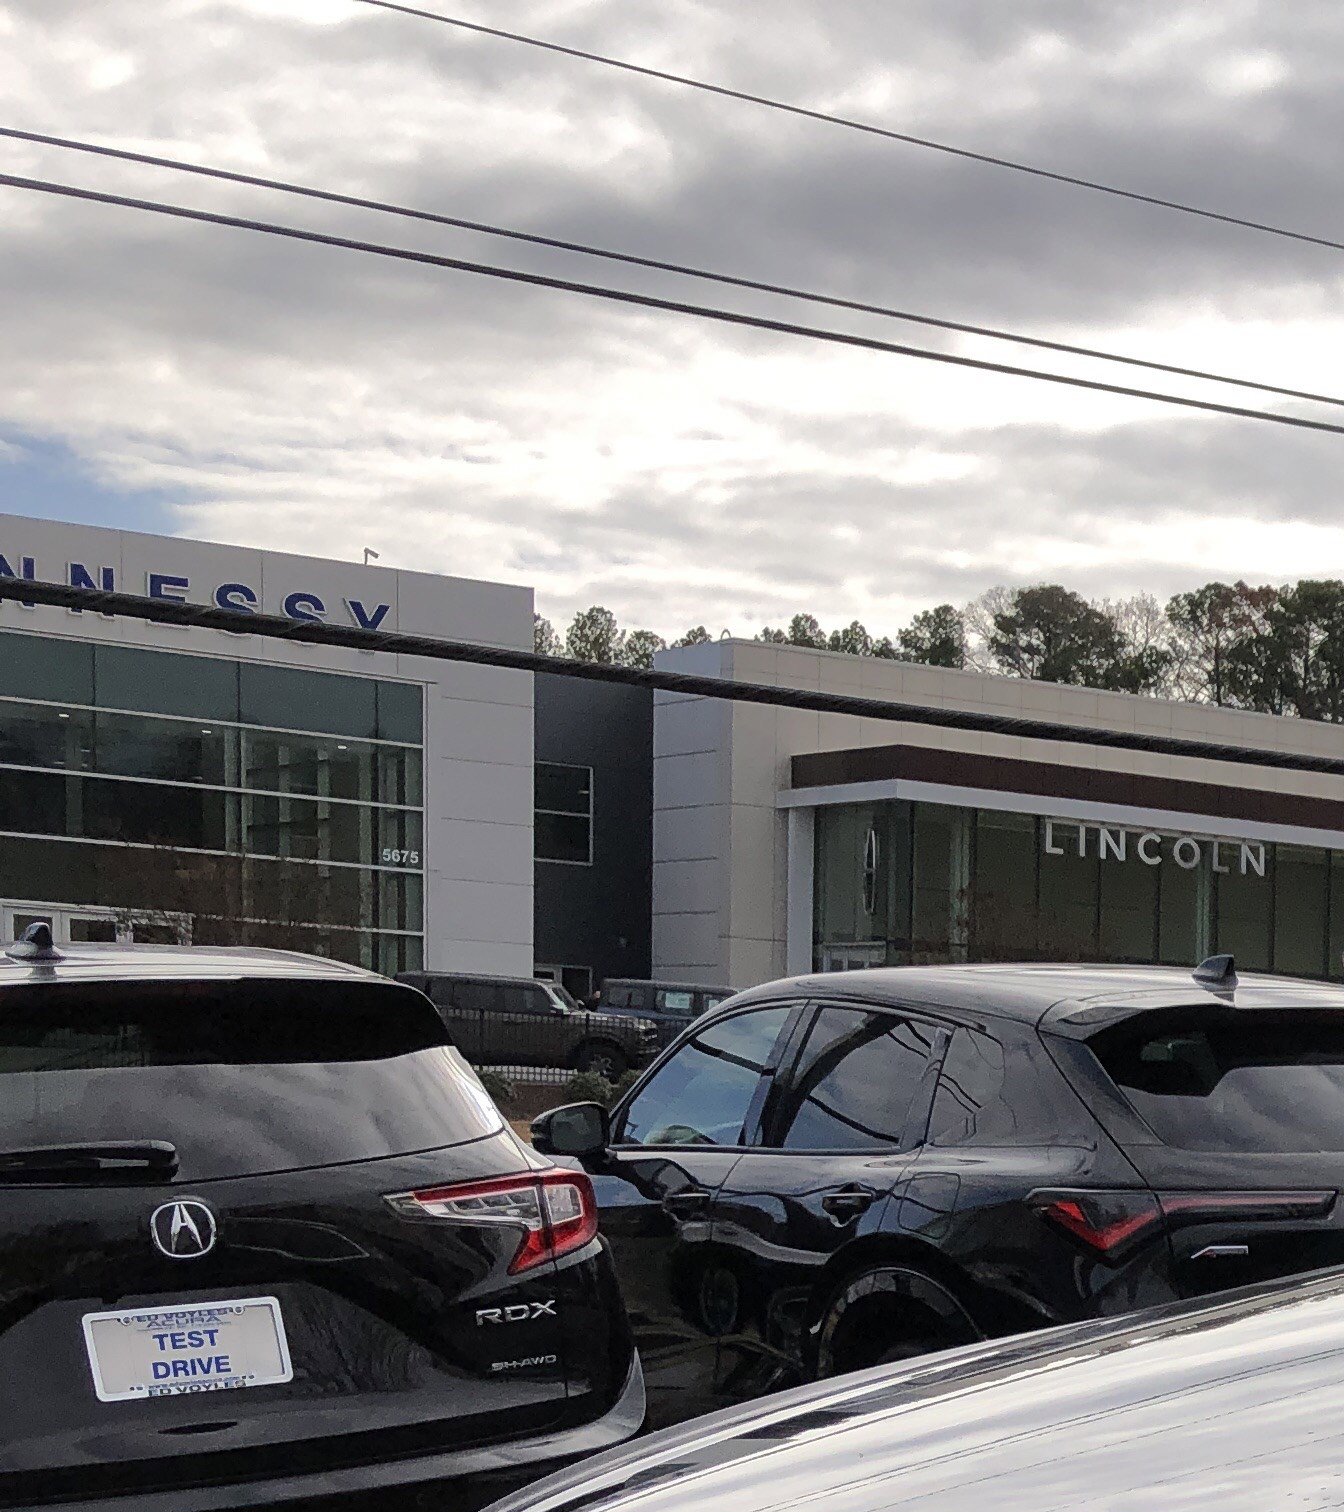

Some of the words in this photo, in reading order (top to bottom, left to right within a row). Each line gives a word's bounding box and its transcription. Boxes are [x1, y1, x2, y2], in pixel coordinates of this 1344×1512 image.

[382, 848, 419, 864] 5675
[1045, 818, 1265, 877] LINCOLN
[475, 1300, 557, 1326] RDX
[152, 1328, 219, 1351] TEST
[151, 1355, 232, 1379] DRIVE
